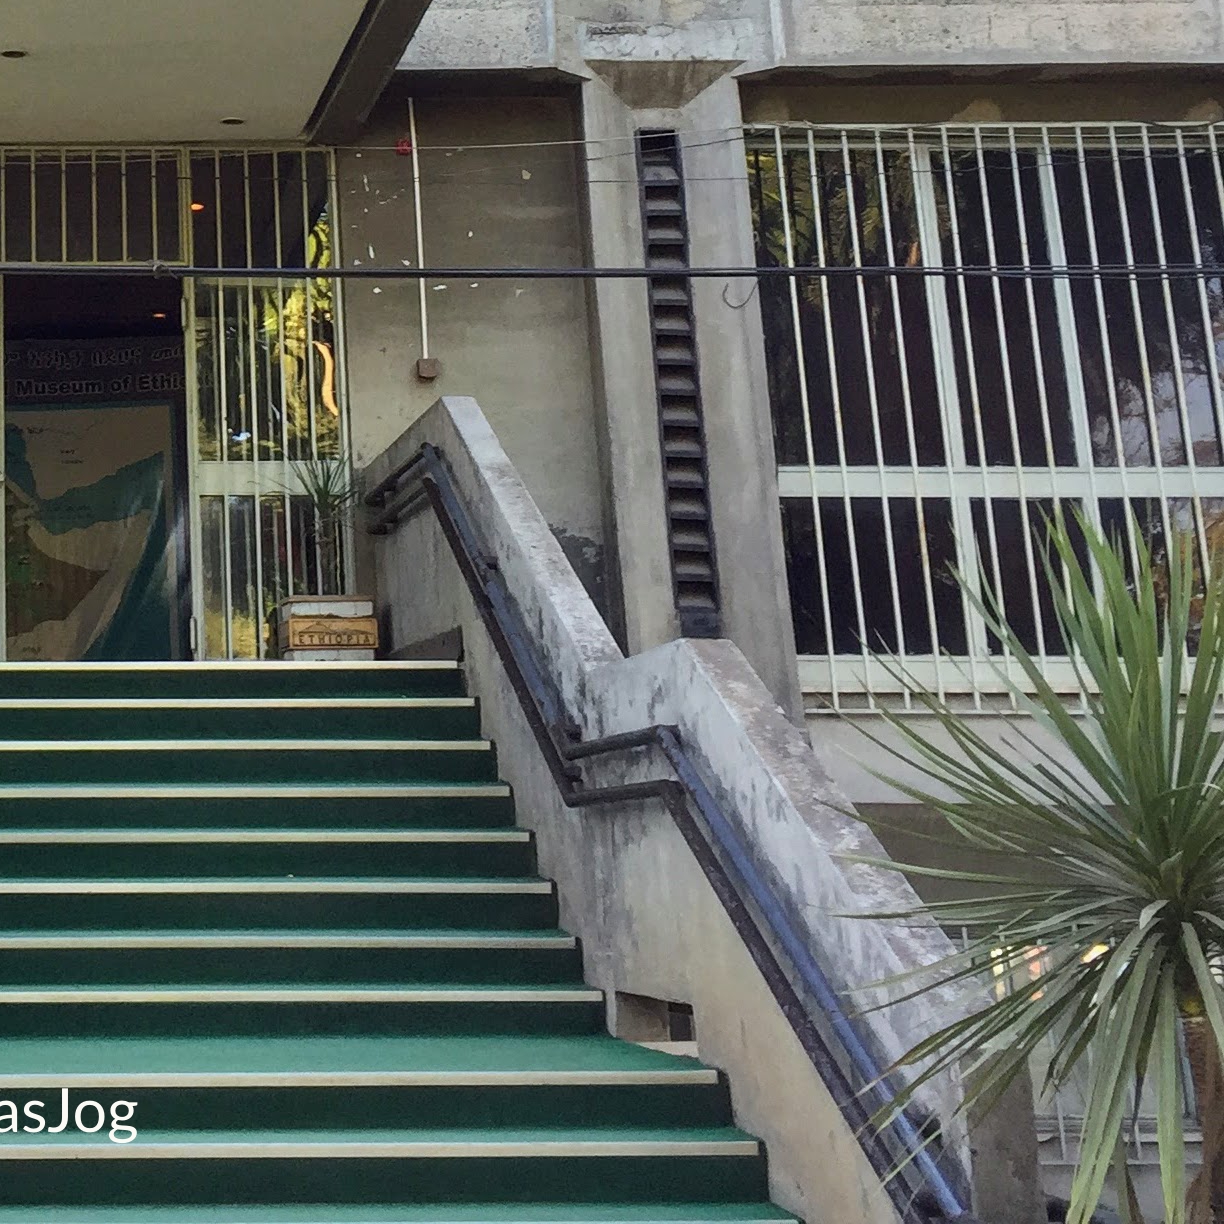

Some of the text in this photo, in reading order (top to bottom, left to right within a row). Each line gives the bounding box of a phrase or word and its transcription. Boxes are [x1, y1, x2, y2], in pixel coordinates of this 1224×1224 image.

[16, 379, 103, 396] Museum
[109, 374, 130, 393] of
[298, 634, 371, 645] ETHIOPIA
